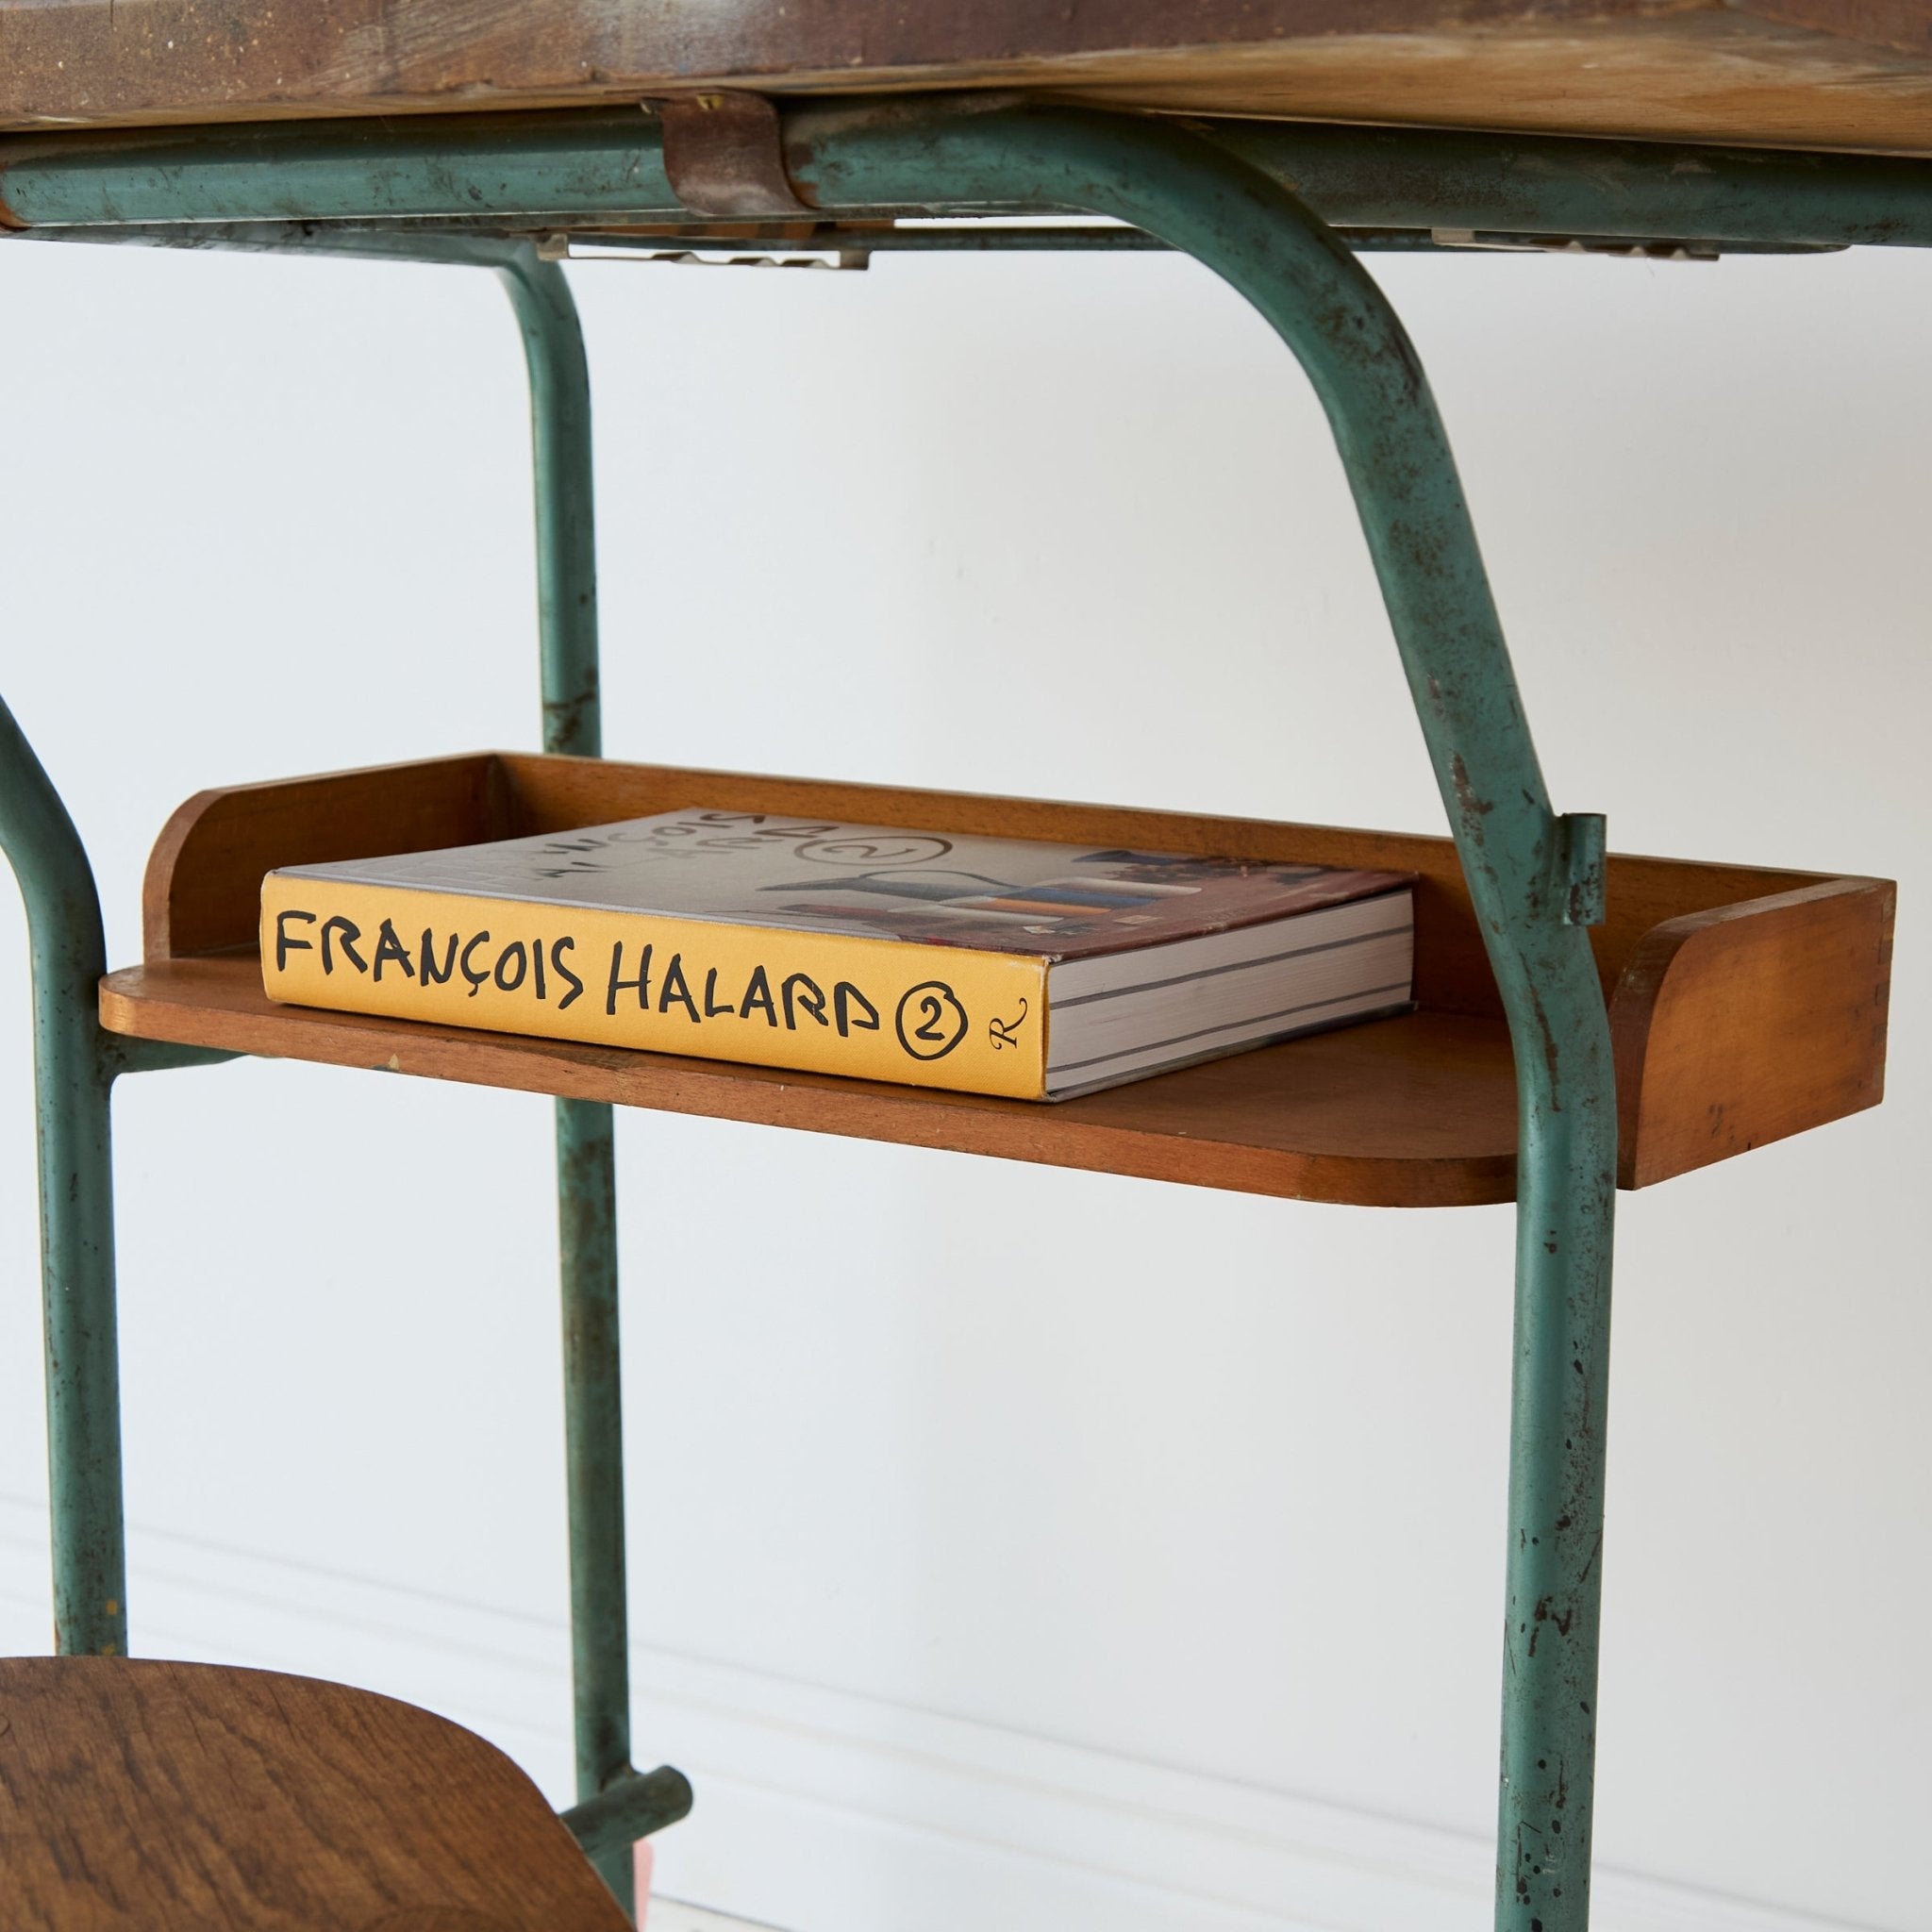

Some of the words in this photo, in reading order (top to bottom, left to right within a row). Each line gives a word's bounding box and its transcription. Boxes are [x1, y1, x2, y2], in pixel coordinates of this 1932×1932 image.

[276, 909, 584, 1010] FRANÇOIS
[606, 941, 881, 1038] HALARD
[989, 997, 1027, 1050] R
